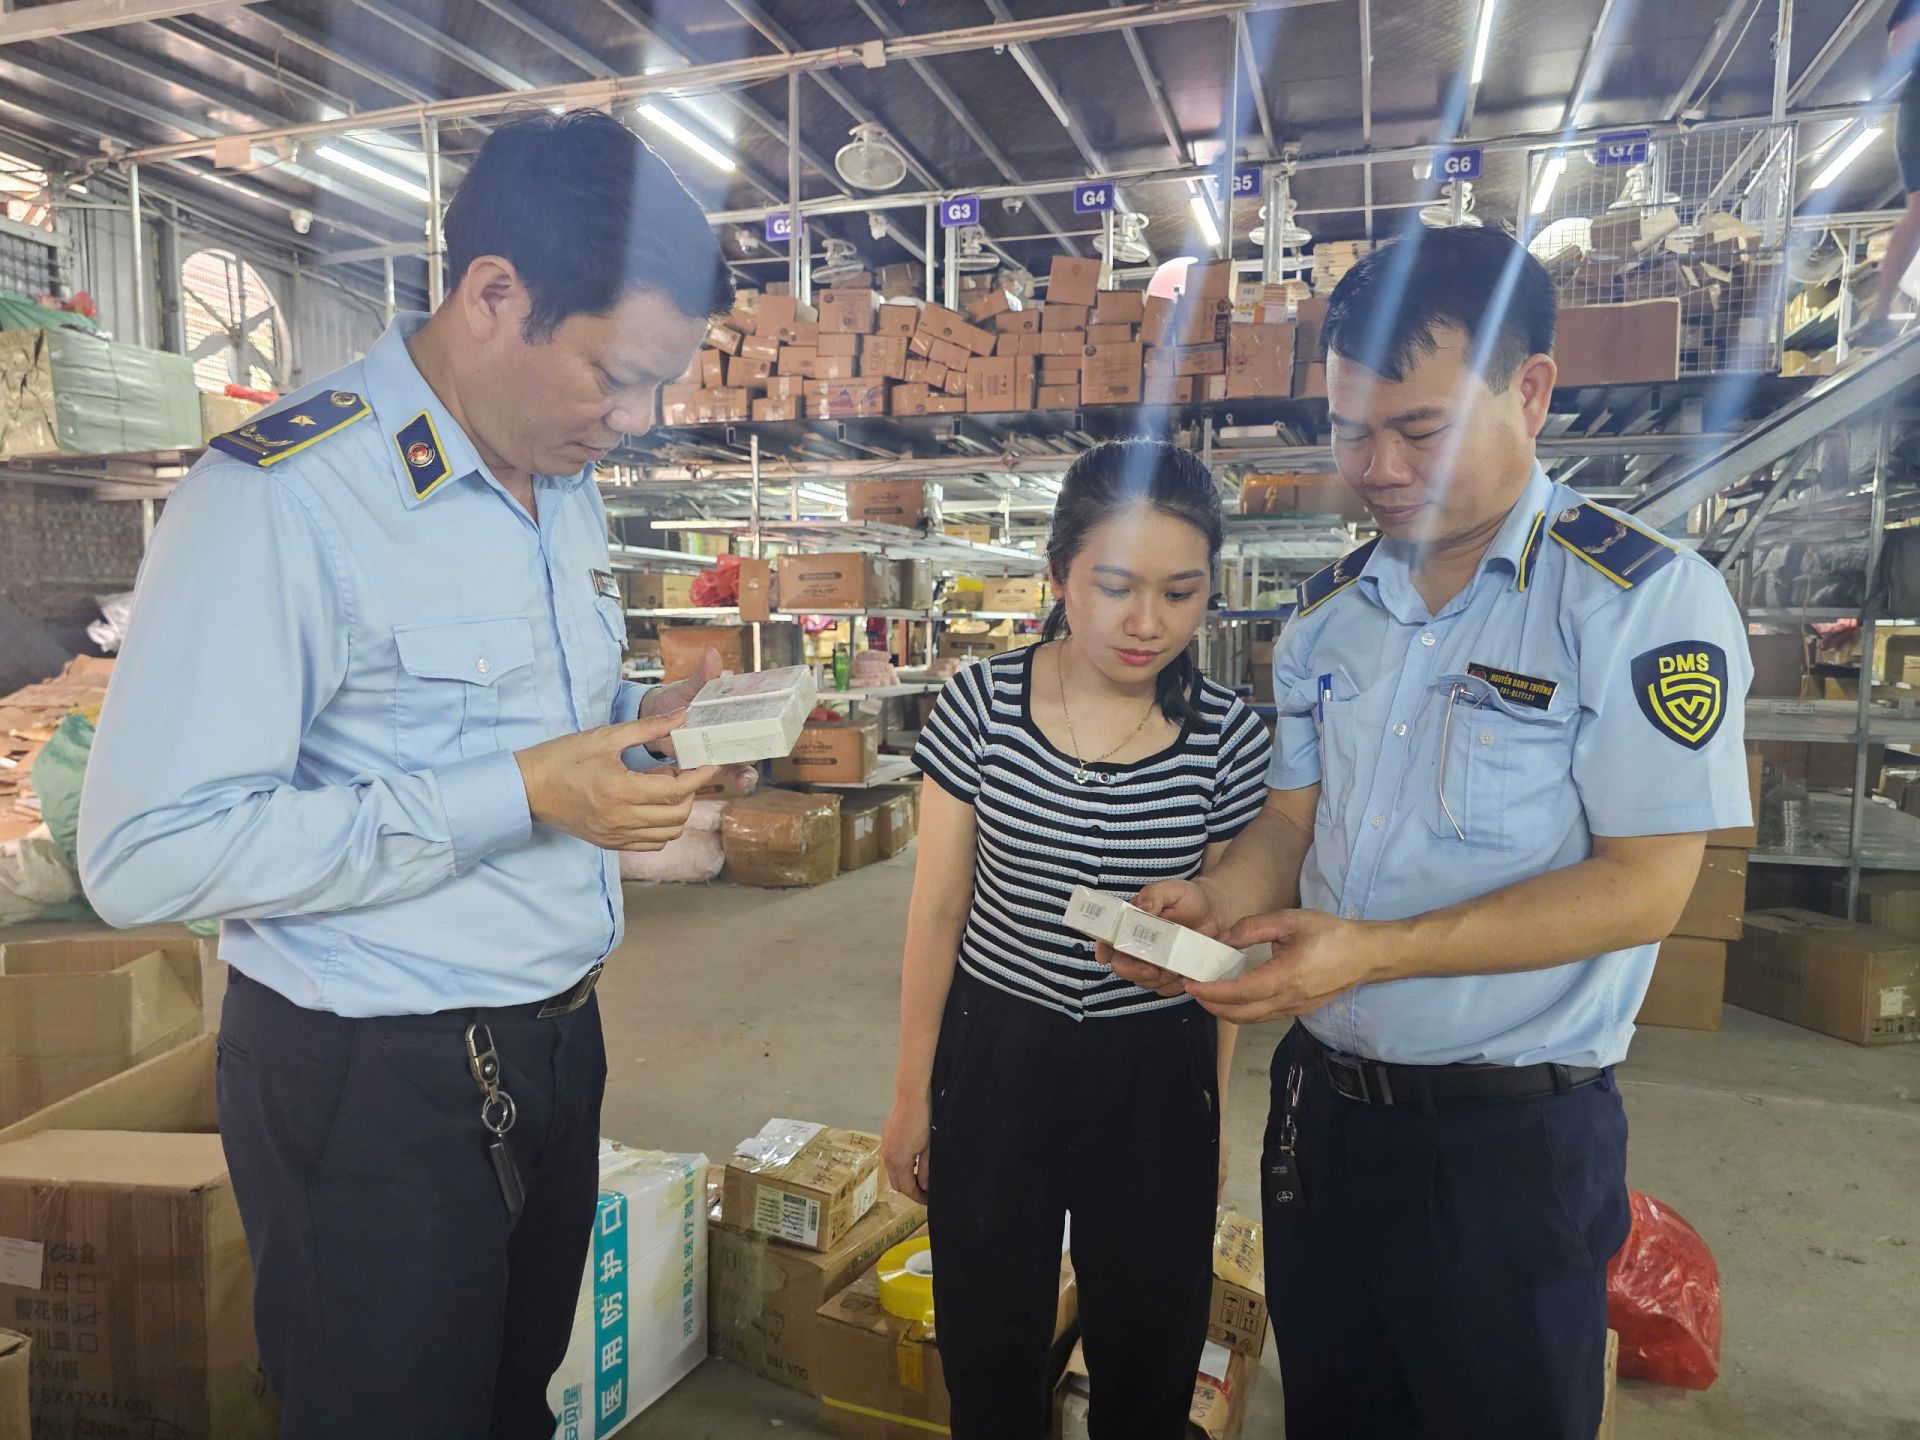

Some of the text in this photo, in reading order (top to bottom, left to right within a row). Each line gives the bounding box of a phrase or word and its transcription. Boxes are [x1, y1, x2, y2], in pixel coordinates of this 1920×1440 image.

[1444, 156, 1471, 174] G6
[1082, 190, 1105, 207] G4
[948, 203, 971, 220] G3
[1658, 652, 1710, 674] DMS
[601, 1200, 623, 1421] 医用防护口
